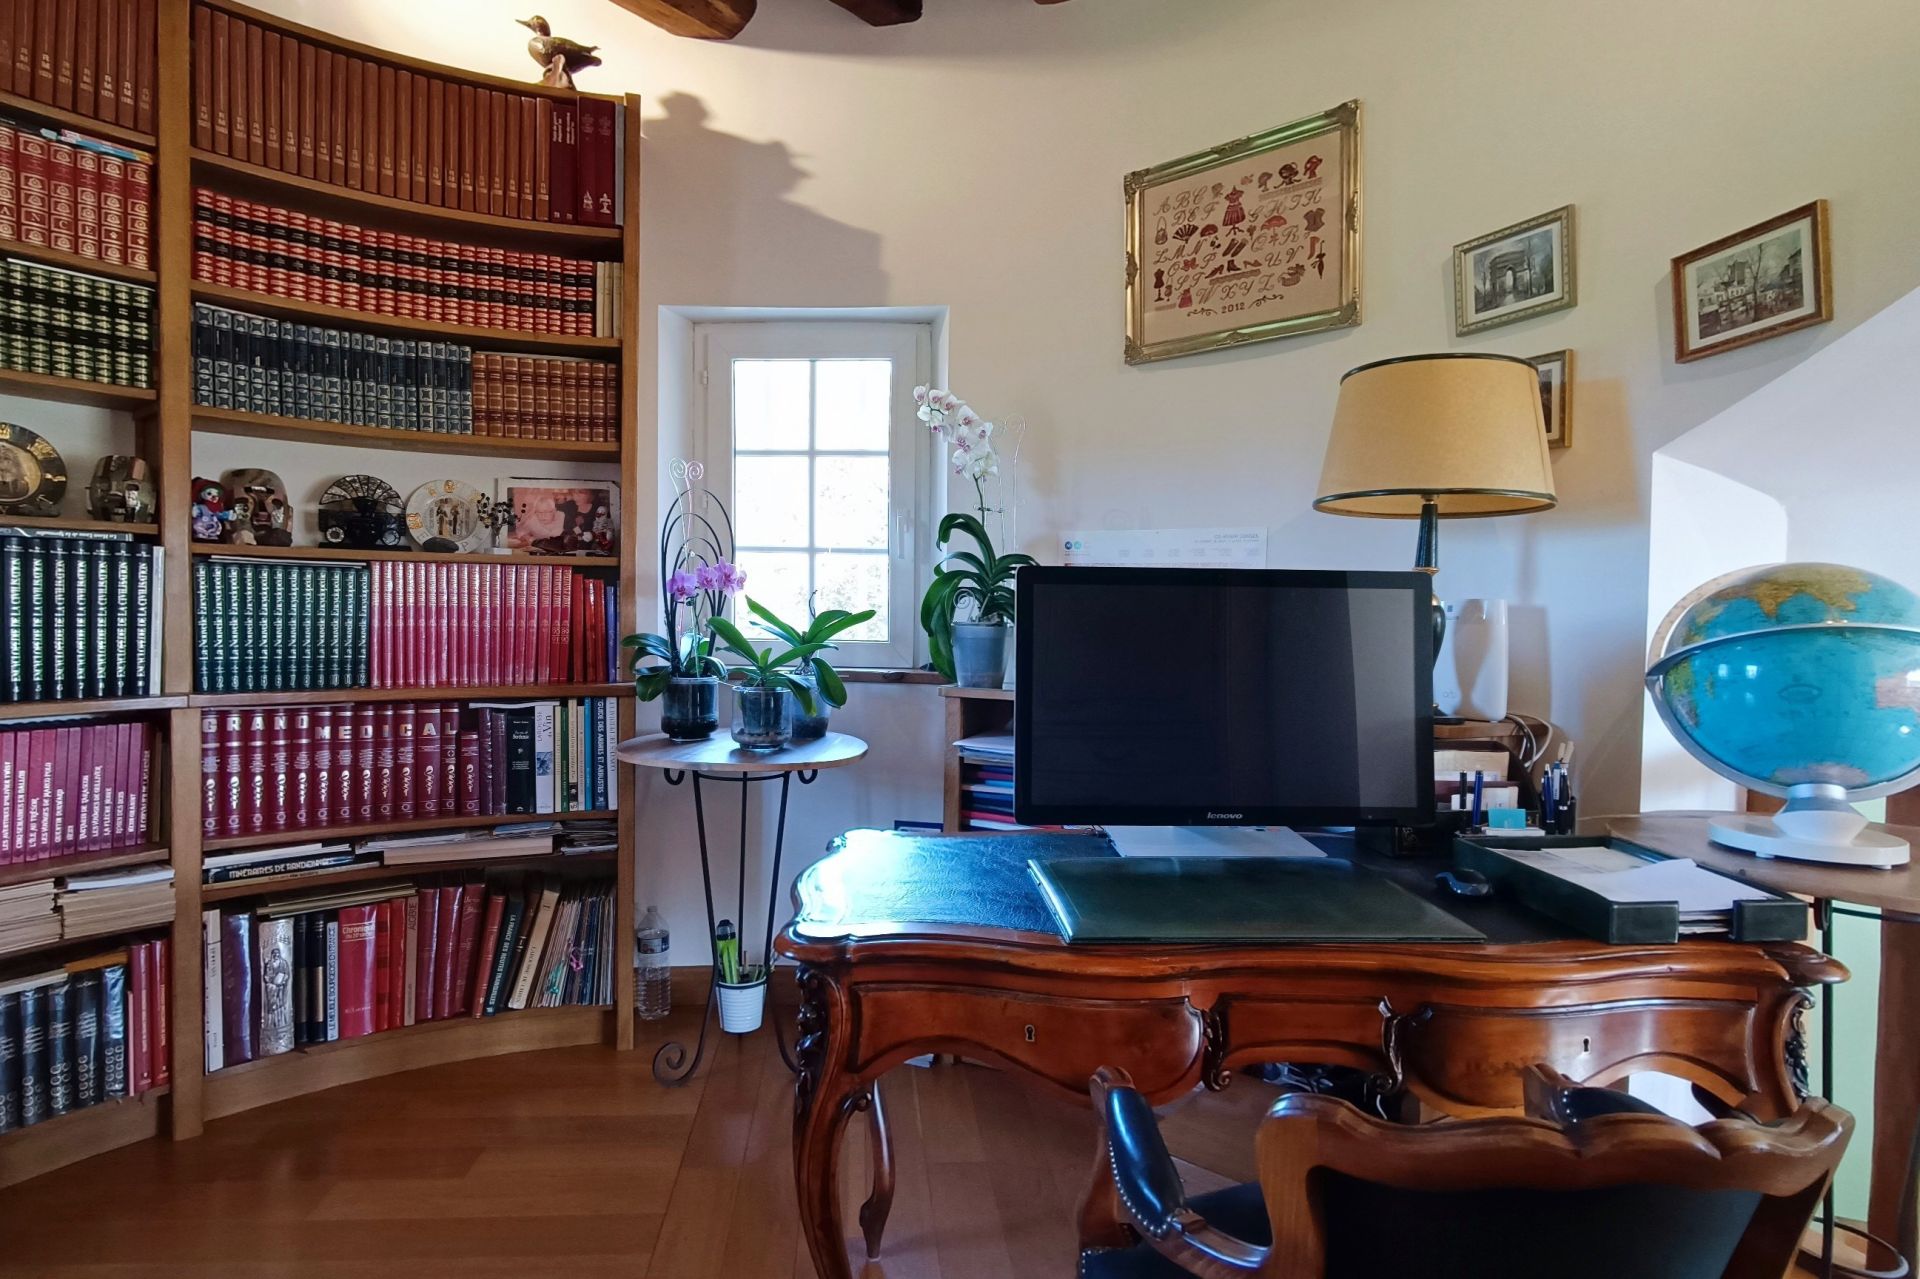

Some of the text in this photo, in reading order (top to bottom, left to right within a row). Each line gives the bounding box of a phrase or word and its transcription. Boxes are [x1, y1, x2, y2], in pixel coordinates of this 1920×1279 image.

[1221, 303, 1245, 313] 2012
[10, 606, 21, 616] LA
[33, 606, 43, 616] LA
[54, 606, 65, 616] LA
[76, 606, 86, 616] LA
[97, 606, 107, 616] LA
[117, 606, 126, 616] LA
[136, 606, 146, 616] LA
[10, 617, 21, 627] DE
[33, 617, 43, 627] DE
[54, 617, 65, 627] DE
[76, 617, 86, 627] DE
[97, 617, 107, 627] DE
[117, 617, 126, 627] DE
[136, 617, 146, 627] DE
[199, 617, 208, 647] Nouvelle
[214, 617, 223, 647] Nouvelle
[229, 617, 239, 647] Nouvelle
[245, 617, 253, 647] Nouvelle
[259, 617, 268, 647] Nouvelle
[274, 617, 283, 647] Nouvelle
[288, 617, 297, 647] Nouvelle
[303, 617, 312, 647] Nouvelle
[317, 617, 326, 647] Nouvelle
[330, 617, 340, 647] Nouvelle
[344, 617, 353, 647] Nouvelle
[359, 618, 368, 647] Nouvelle
[199, 651, 208, 660] La
[214, 651, 223, 659] La
[230, 651, 239, 659] La
[245, 651, 254, 659] La
[259, 650, 268, 659] La
[274, 650, 283, 659] La
[288, 650, 297, 659] La
[302, 650, 312, 659] La
[317, 650, 326, 659] La
[330, 650, 339, 659] La
[343, 650, 353, 658] La
[358, 650, 367, 658] La
[202, 715, 457, 739] GRAND MEDICAL
[543, 715, 552, 732] Vin
[16, 803, 25, 834] SEMAINES
[42, 808, 50, 832] VOYAGES
[1207, 811, 1243, 819] lenovo
[275, 864, 285, 873] DE
[510, 914, 516, 922] LA
[505, 922, 515, 940] FRANCE
[502, 942, 510, 952] DES
[497, 953, 507, 971] ROUTES
